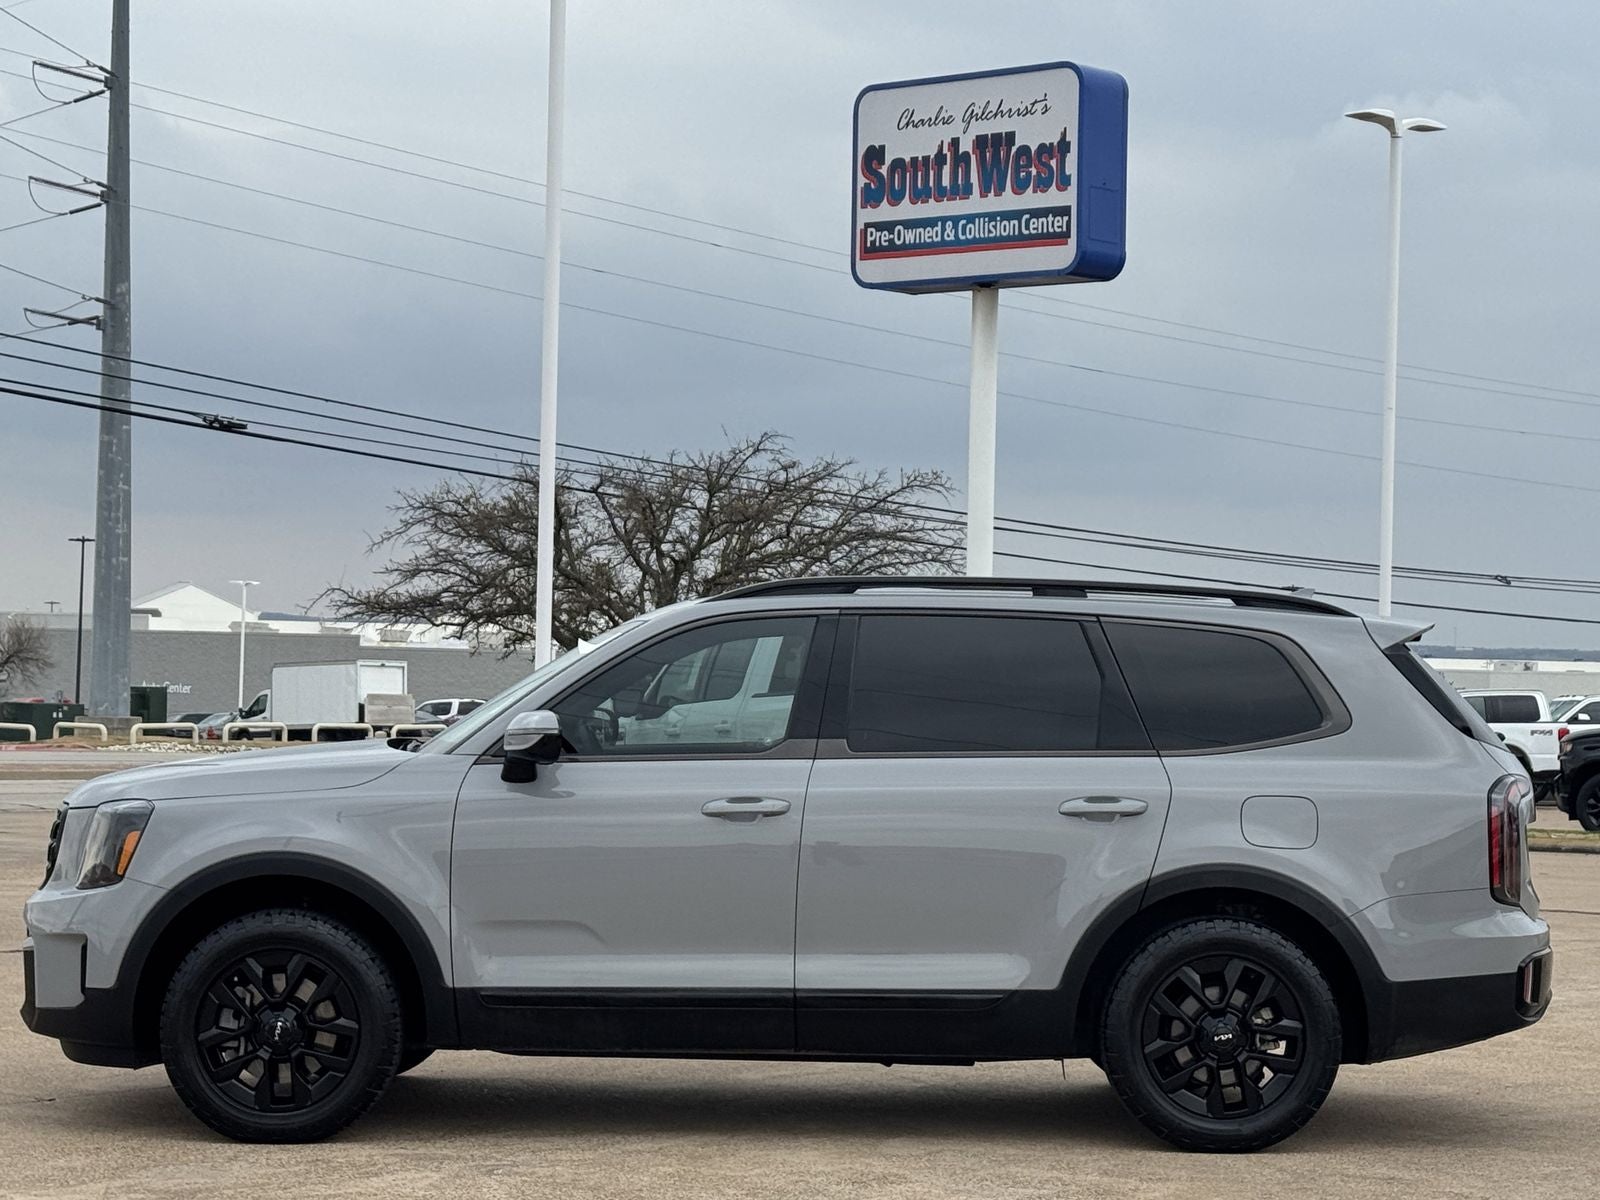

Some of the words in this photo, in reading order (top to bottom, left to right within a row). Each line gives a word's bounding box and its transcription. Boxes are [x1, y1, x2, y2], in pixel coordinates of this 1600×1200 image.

[897, 105, 955, 131] Charlie
[961, 92, 1052, 134] Gilchrist's
[866, 222, 942, 248] Pre-Owned
[944, 220, 955, 241] &
[957, 216, 1019, 240] Collision
[1021, 213, 1069, 235] Center
